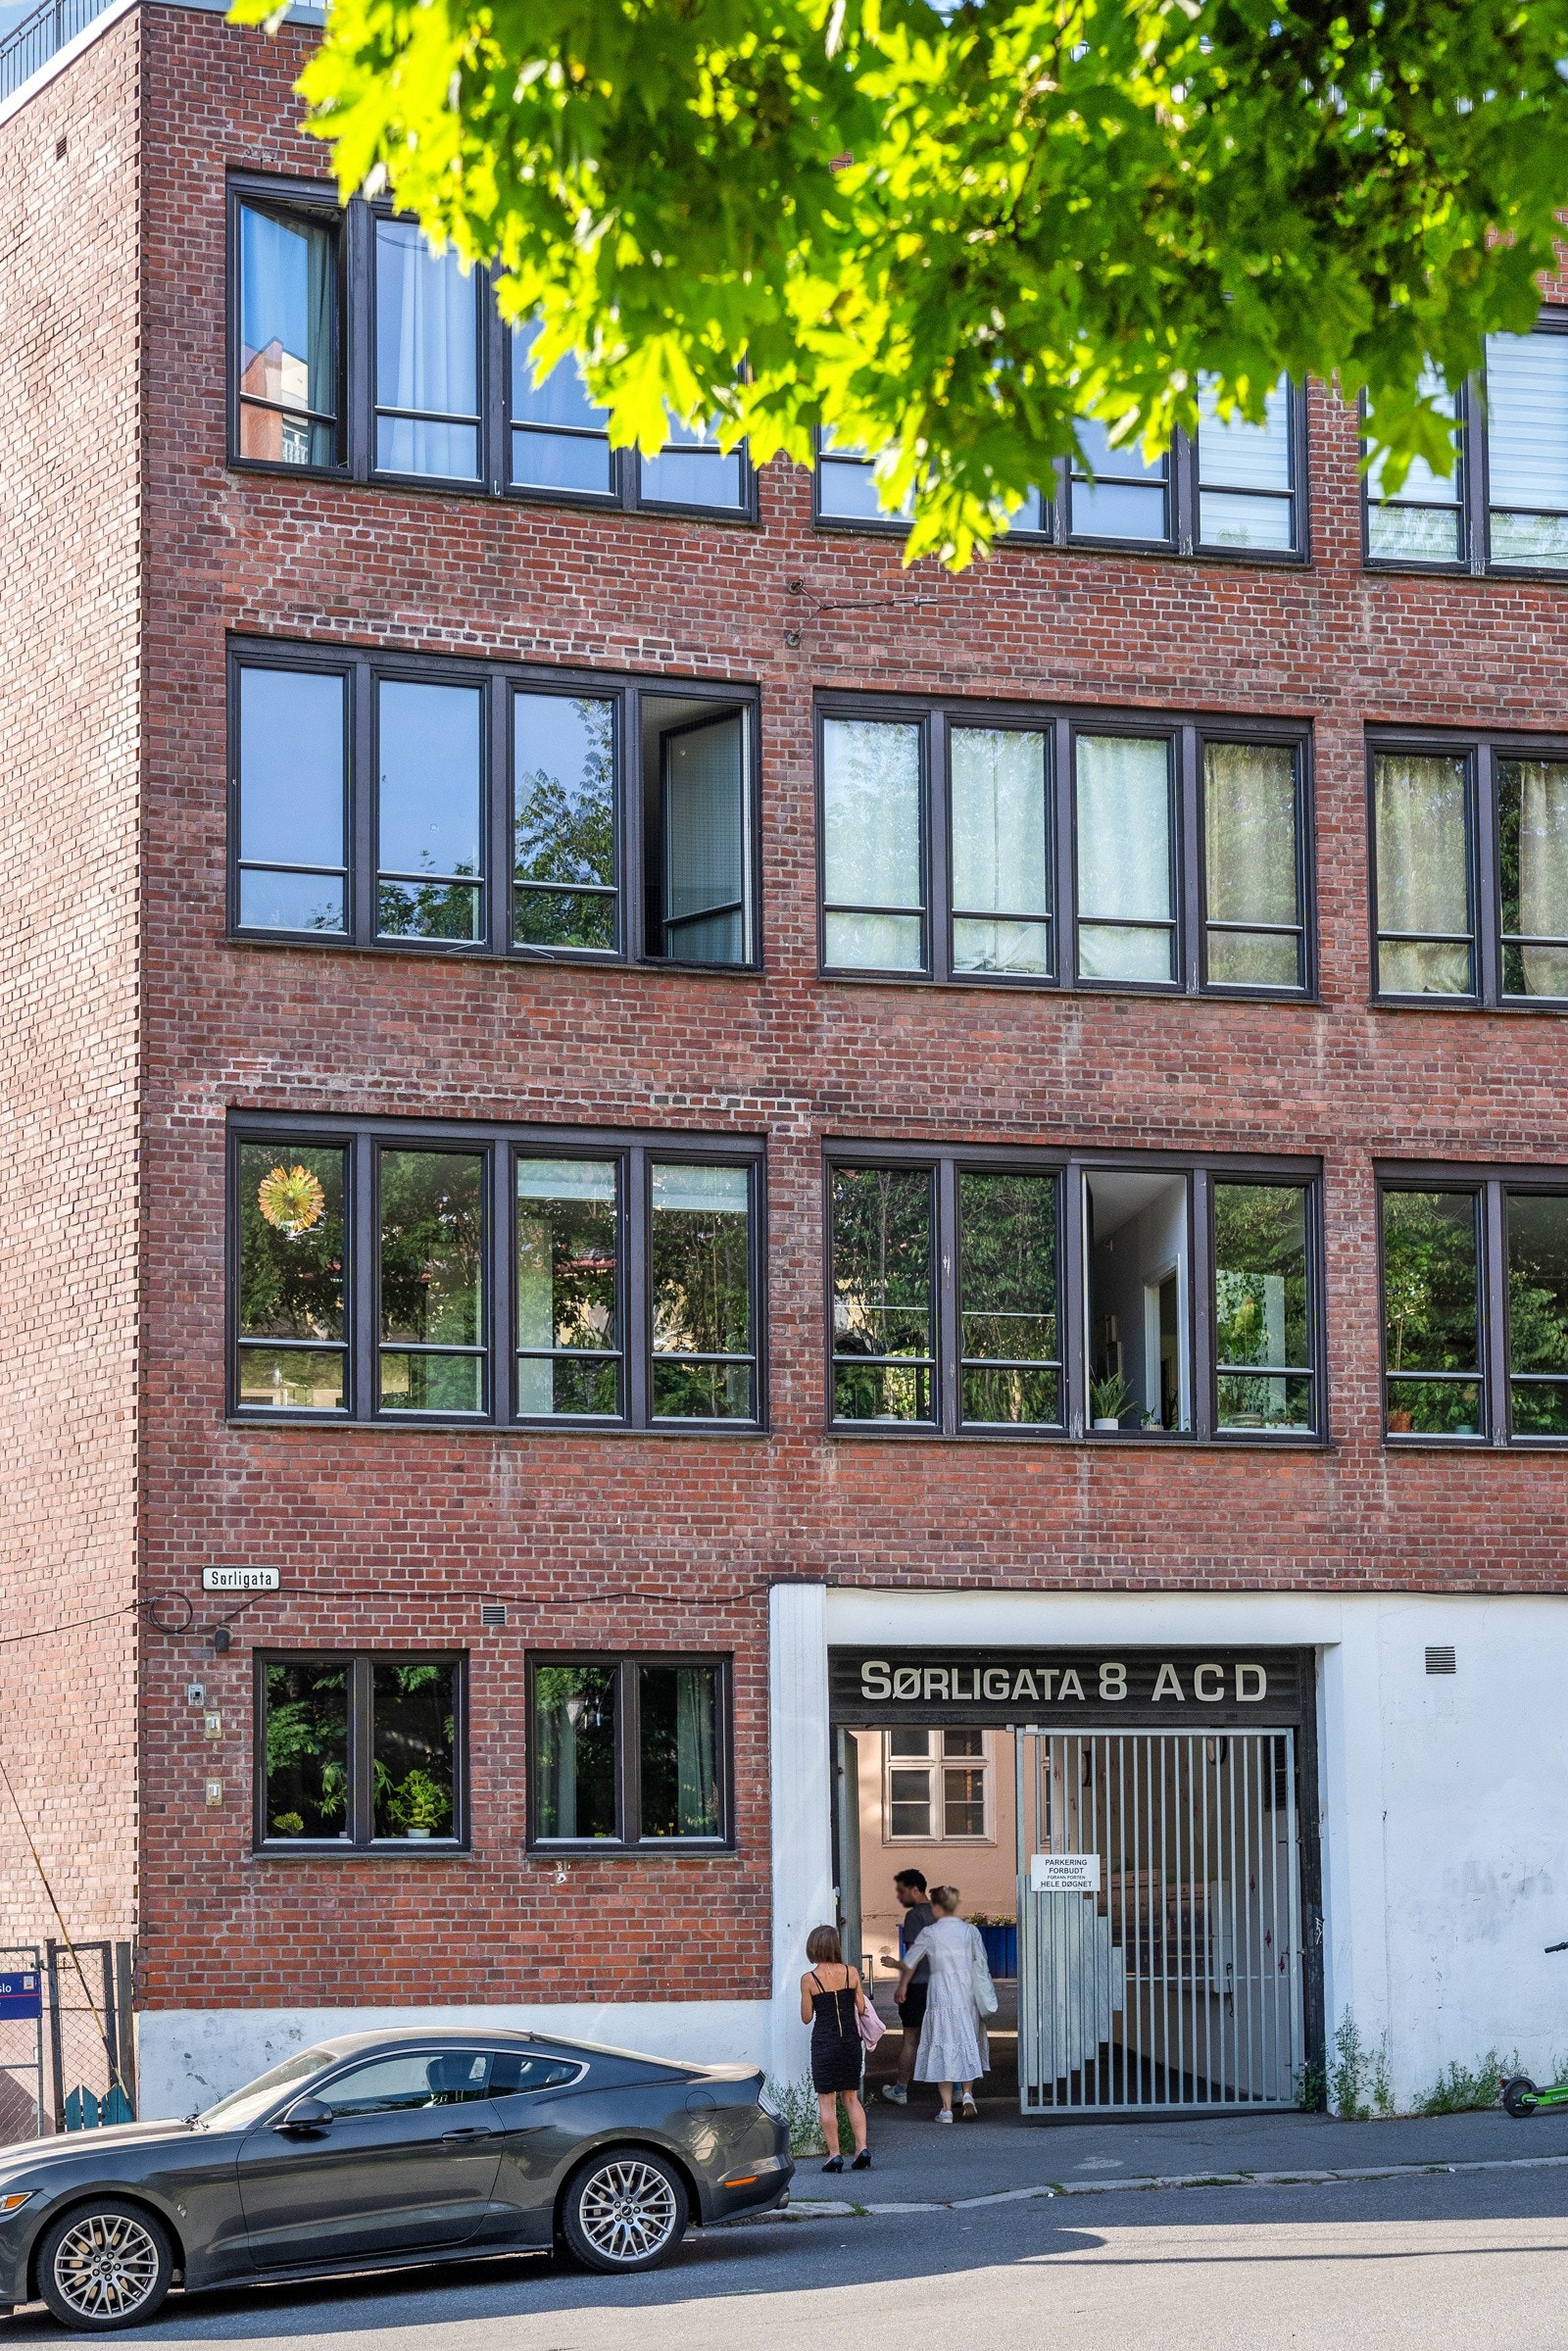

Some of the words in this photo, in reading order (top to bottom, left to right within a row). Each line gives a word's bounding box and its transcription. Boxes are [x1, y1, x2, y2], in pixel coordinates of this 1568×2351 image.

[212, 1571, 271, 1589] Sørligata
[860, 1660, 1086, 1700] SØRLIGATA
[1099, 1662, 1128, 1701] 8
